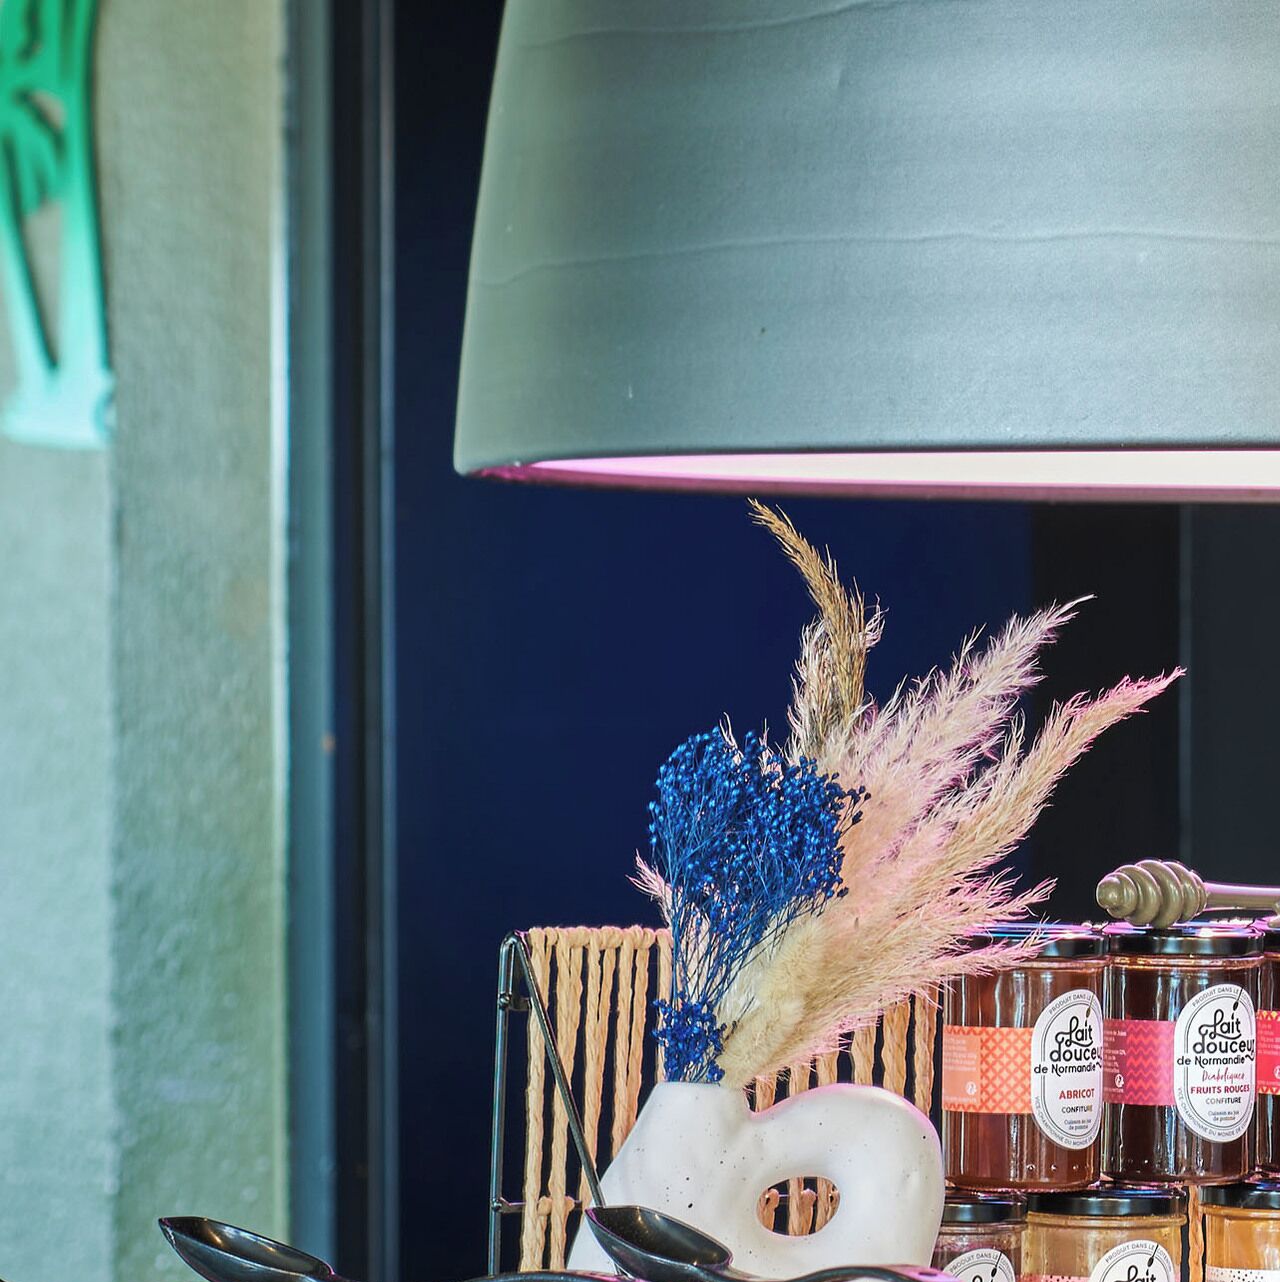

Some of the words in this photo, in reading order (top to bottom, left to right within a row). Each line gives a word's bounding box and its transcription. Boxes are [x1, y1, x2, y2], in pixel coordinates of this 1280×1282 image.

[1199, 1009, 1241, 1040] Lait
[1055, 1016, 1093, 1047] Lait
[1177, 1056, 1191, 1066] de
[1195, 1055, 1245, 1068] Normandie
[1034, 1063, 1048, 1074] de
[1051, 1062, 1096, 1077] Normandie
[1059, 1088, 1095, 1100] ABRICOT
[1190, 1086, 1222, 1095] FRUITS
[1224, 1084, 1250, 1093] ROUGES
[1206, 1097, 1241, 1105] CONFITURE
